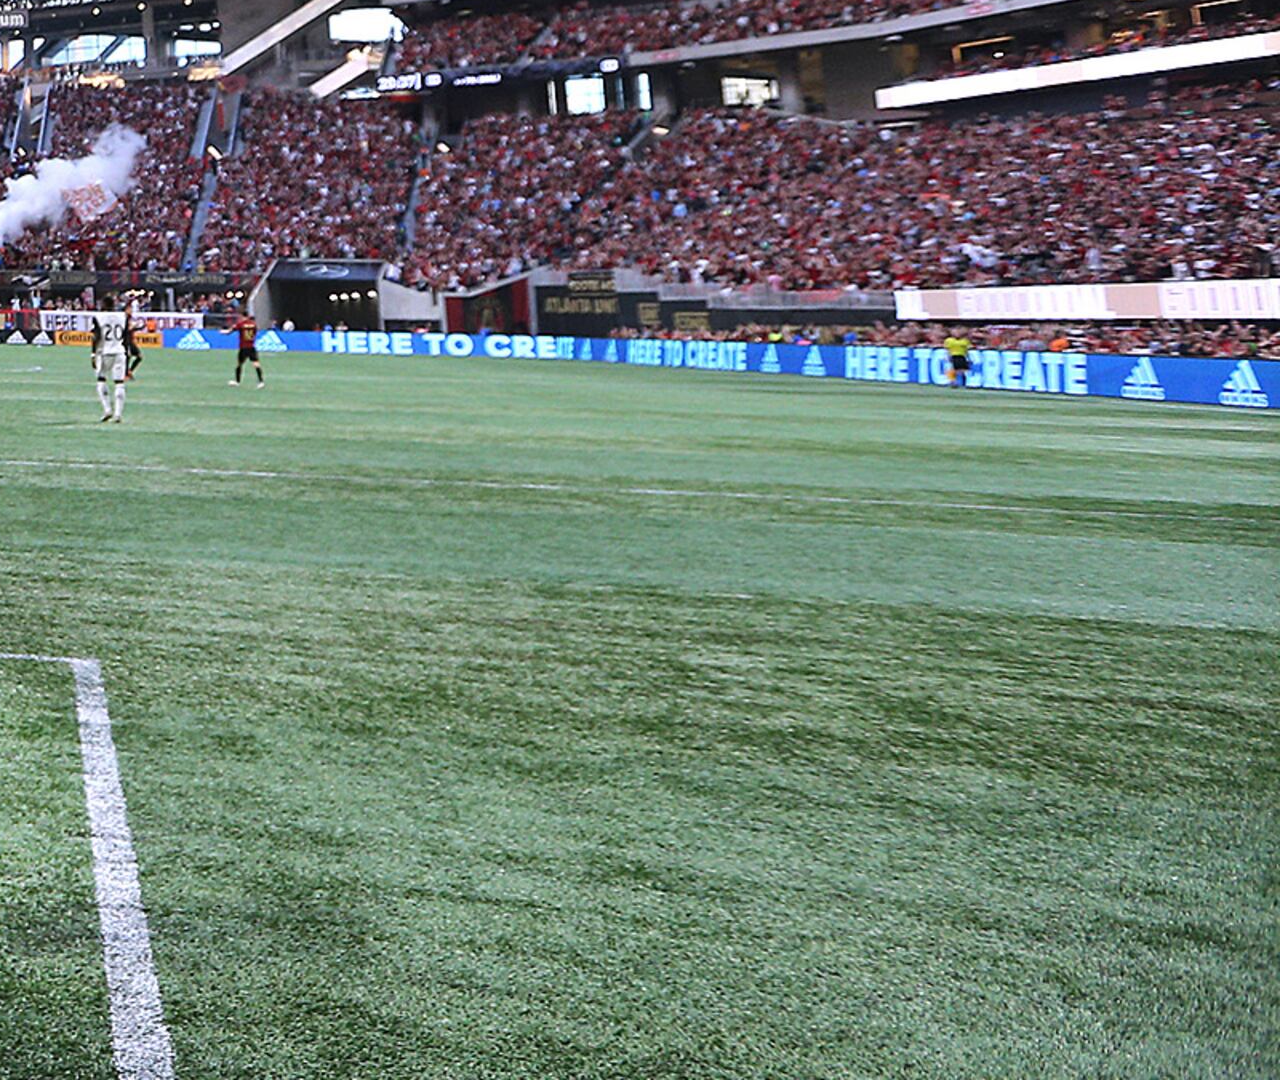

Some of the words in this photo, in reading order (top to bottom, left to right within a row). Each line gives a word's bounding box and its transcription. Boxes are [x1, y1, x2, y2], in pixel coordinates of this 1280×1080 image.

[45, 315, 77, 331] HERE
[103, 324, 123, 341] 20
[321, 331, 413, 355] HERE
[422, 333, 474, 357] TO
[627, 340, 662, 366] HERE
[664, 340, 684, 367] TO
[684, 341, 747, 370] CREATE
[845, 346, 909, 382] HERE
[913, 348, 951, 386] TO
[966, 349, 1088, 394] CREATE
